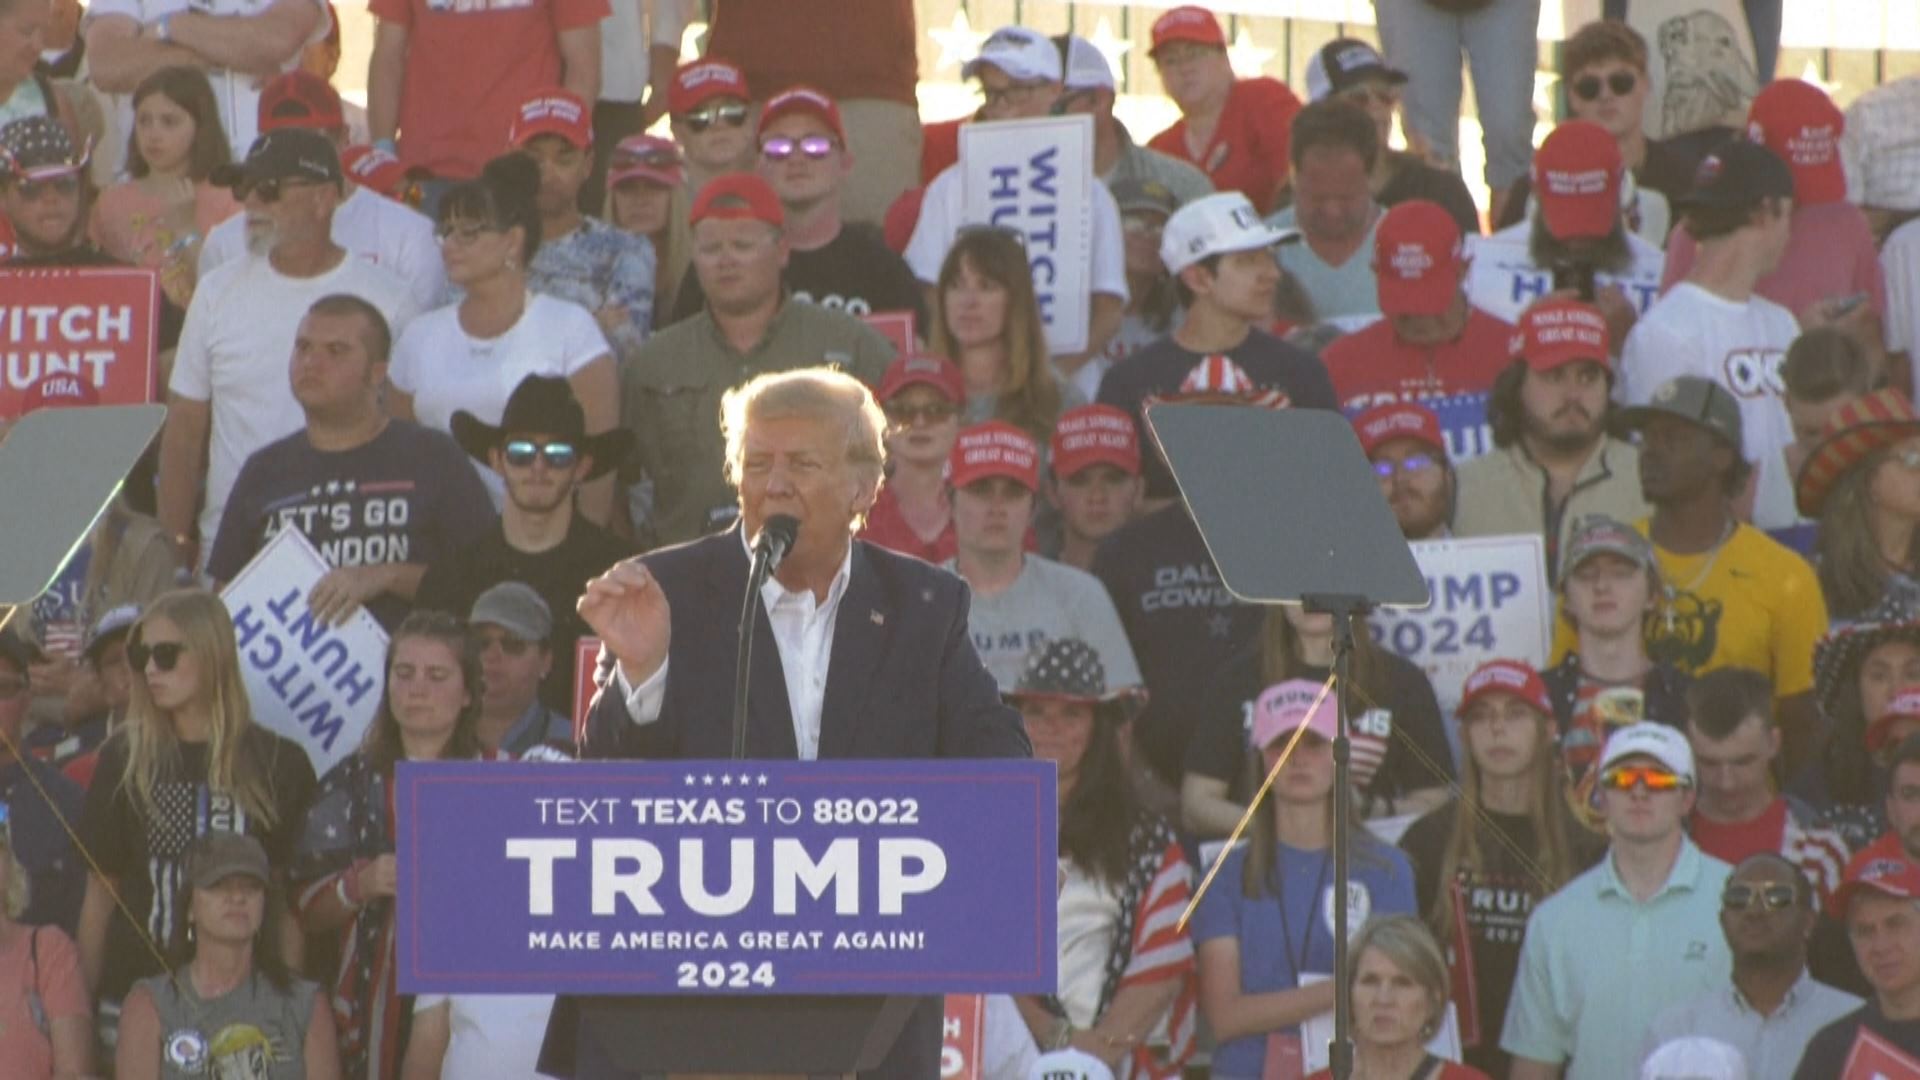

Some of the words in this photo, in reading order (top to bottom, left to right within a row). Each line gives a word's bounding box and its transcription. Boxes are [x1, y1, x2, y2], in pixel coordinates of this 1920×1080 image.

[0, 305, 131, 343] ITCH
[0, 351, 115, 389] UNT
[364, 498, 409, 527] GO
[320, 534, 409, 568] NDON
[1155, 564, 1215, 587] DAL
[267, 587, 374, 707] HUNT
[234, 604, 345, 752] WITCH
[535, 799, 620, 824] TEXT
[632, 799, 746, 824] TEXAS
[757, 799, 801, 824] TO
[813, 799, 919, 824] 88022
[506, 838, 947, 915] TRUMP
[529, 932, 601, 949] MAKE
[611, 932, 728, 949] AMERICA
[739, 932, 823, 949] GREAT
[834, 932, 925, 949] AGAIN!
[678, 962, 775, 987] 2024
